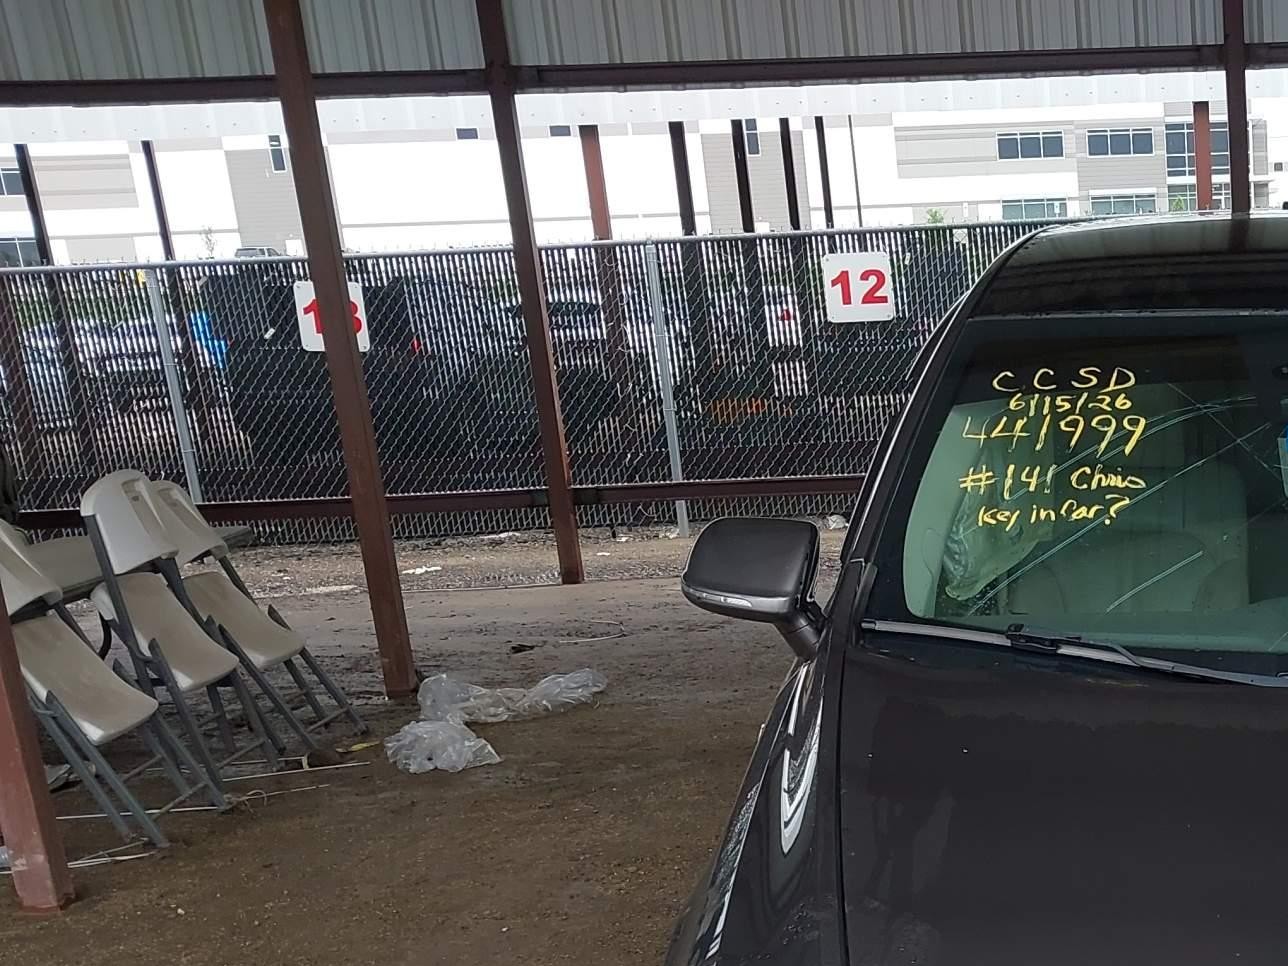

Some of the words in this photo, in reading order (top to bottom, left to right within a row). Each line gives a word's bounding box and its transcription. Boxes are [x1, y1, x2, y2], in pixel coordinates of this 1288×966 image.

[831, 269, 888, 305] 12
[1009, 392, 1132, 416] 6/15/26
[962, 413, 1146, 458] 441999
